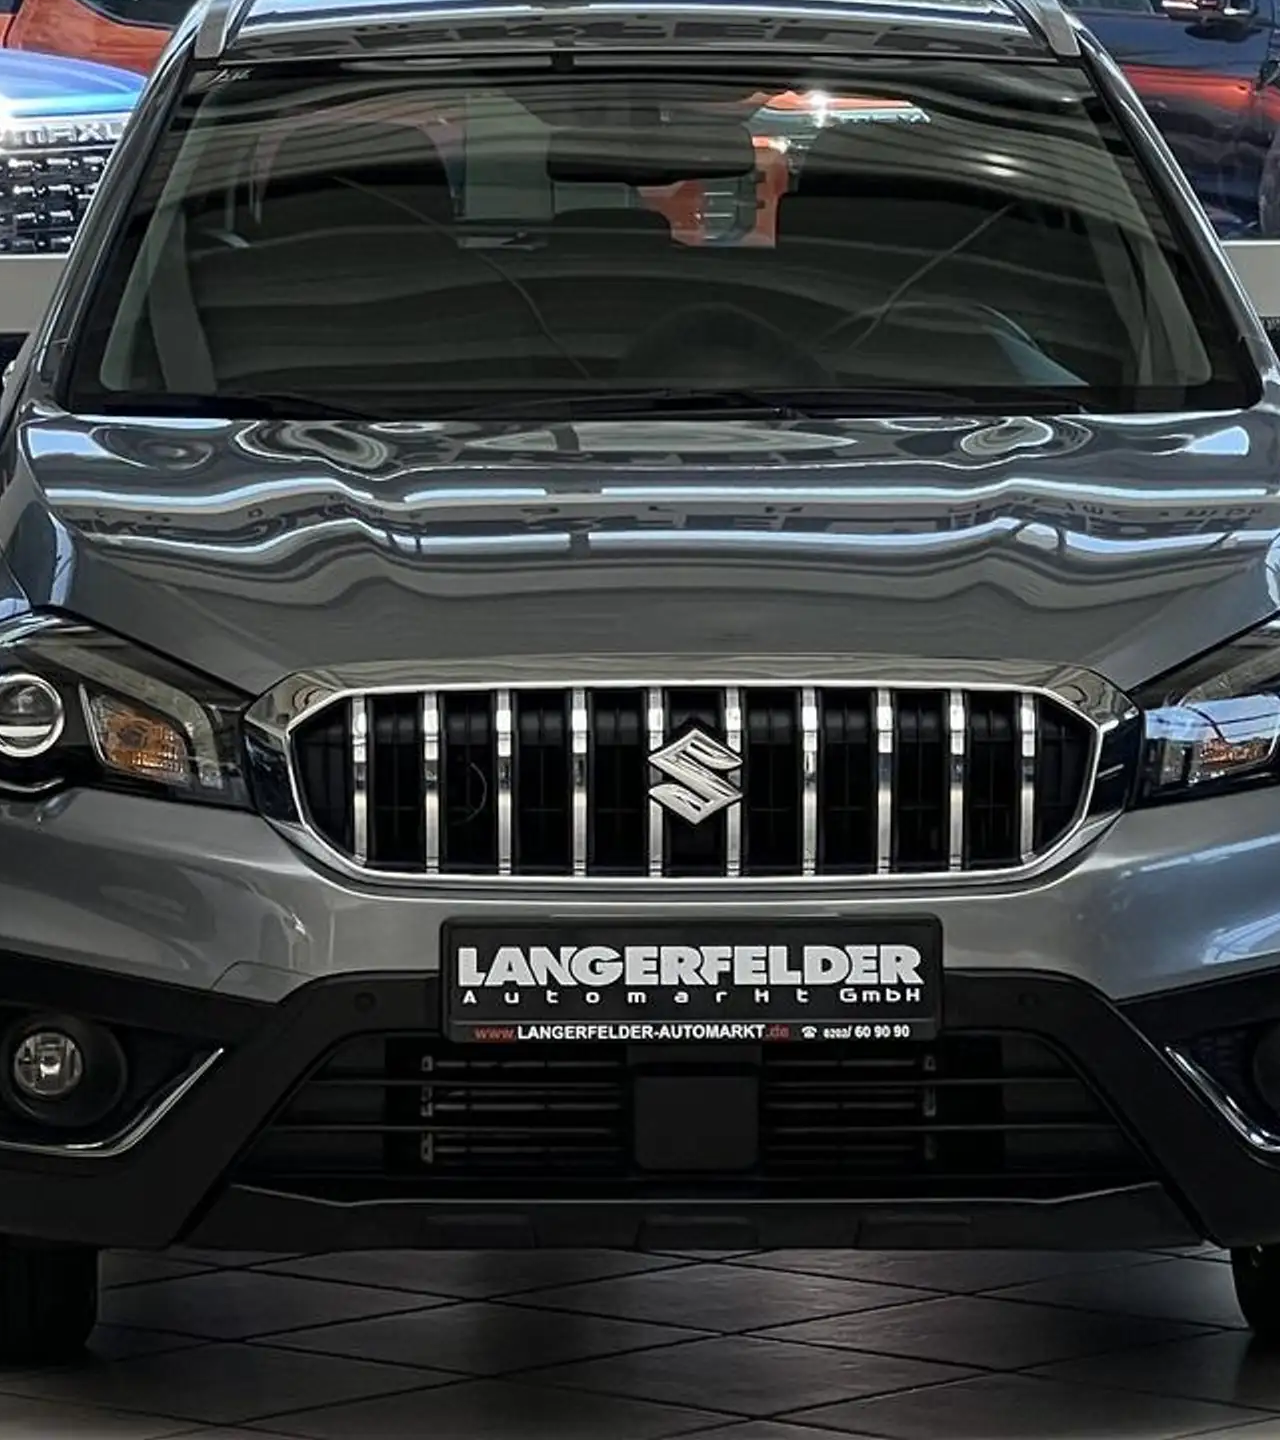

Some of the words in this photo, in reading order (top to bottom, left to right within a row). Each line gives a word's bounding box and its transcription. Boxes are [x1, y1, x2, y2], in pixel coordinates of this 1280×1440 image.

[458, 944, 924, 987] LANGERFELDER
[839, 987, 921, 1003] GmbH
[474, 1023, 790, 1041] www.LANGERFELDER-AUTOMARKT.de
[854, 1025, 872, 1039] 60
[874, 1025, 891, 1038] 90
[893, 1025, 911, 1038] 90
